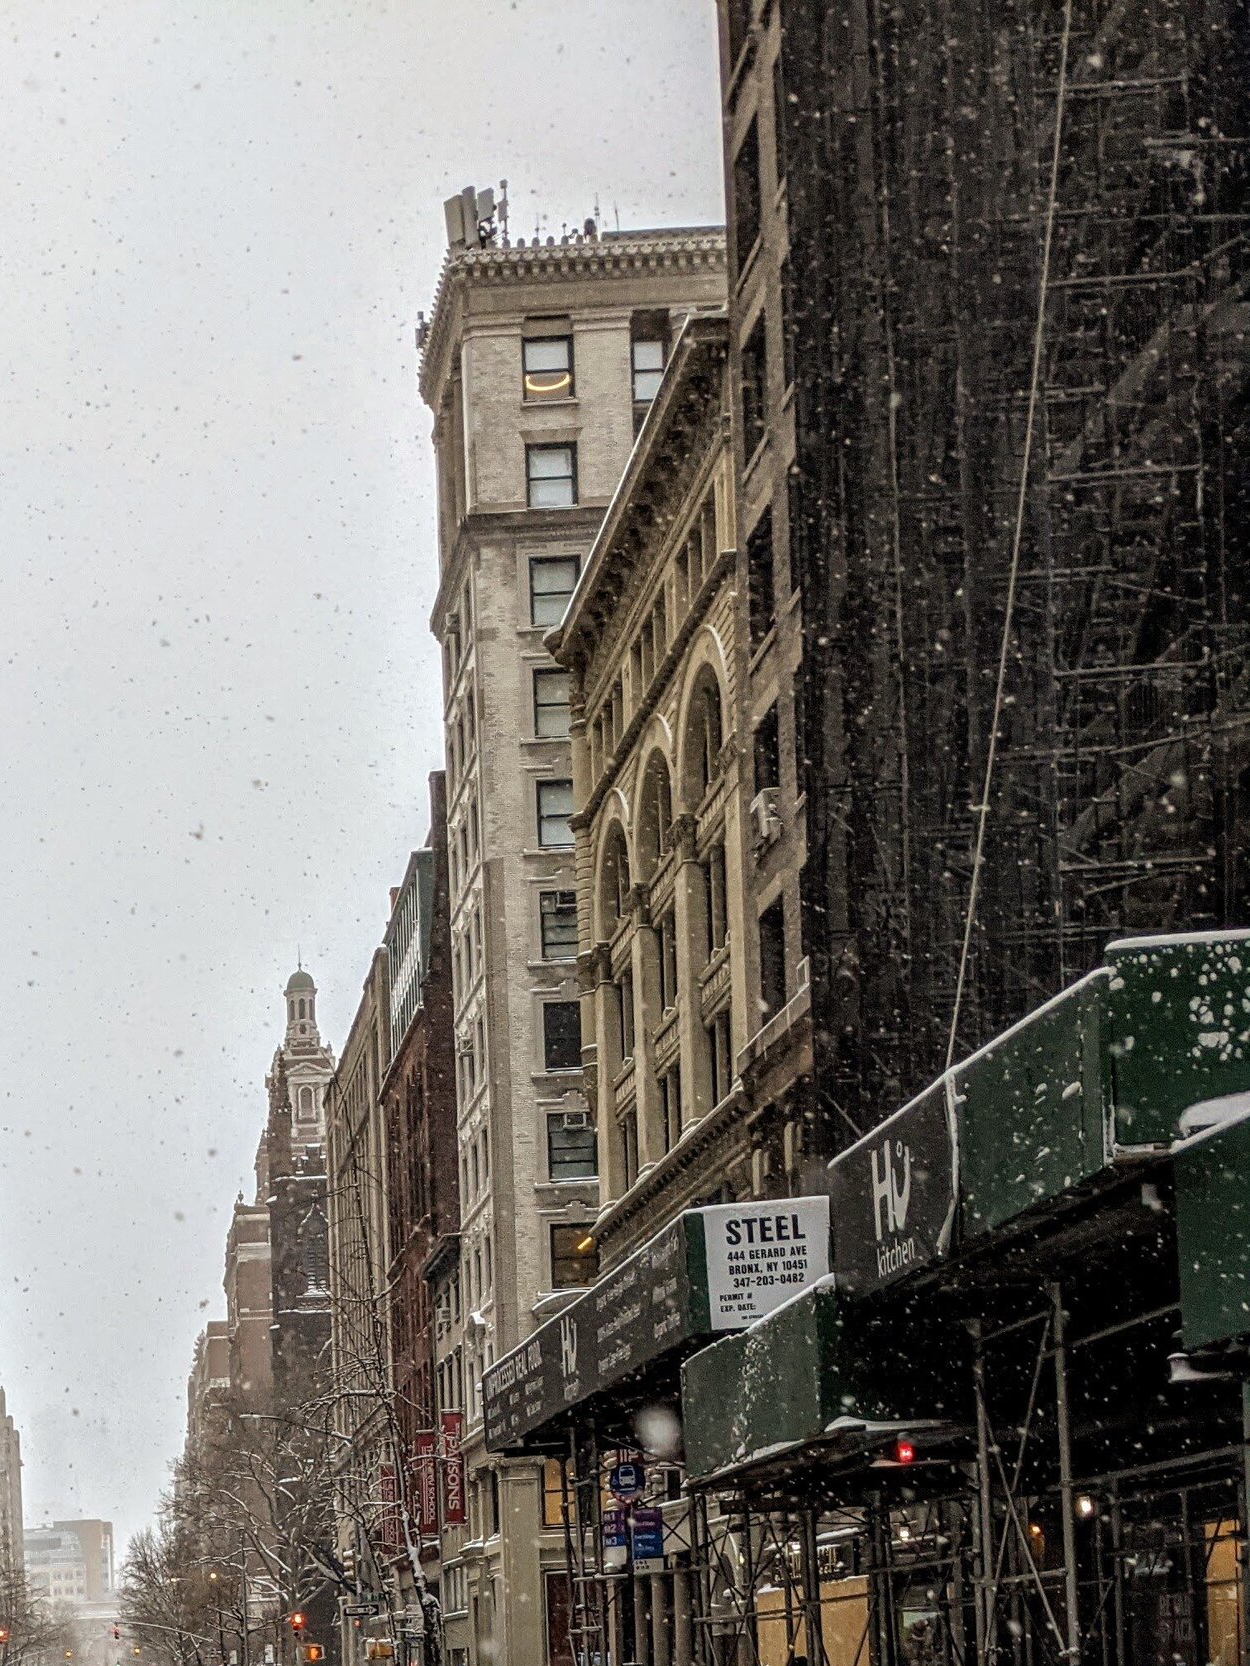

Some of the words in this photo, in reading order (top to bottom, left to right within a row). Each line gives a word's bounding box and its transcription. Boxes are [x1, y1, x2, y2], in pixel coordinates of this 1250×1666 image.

[725, 1214, 806, 1245] STEEL
[727, 1250, 745, 1261] 444
[749, 1247, 786, 1260] GERARD
[790, 1245, 807, 1256] AVE
[876, 1238, 915, 1278] kitchen
[729, 1263, 763, 1275] BRONX,
[767, 1262, 778, 1272] NY
[782, 1260, 808, 1271] 10451
[733, 1272, 805, 1288] 347-203-0482
[720, 1292, 745, 1301] PERMIT
